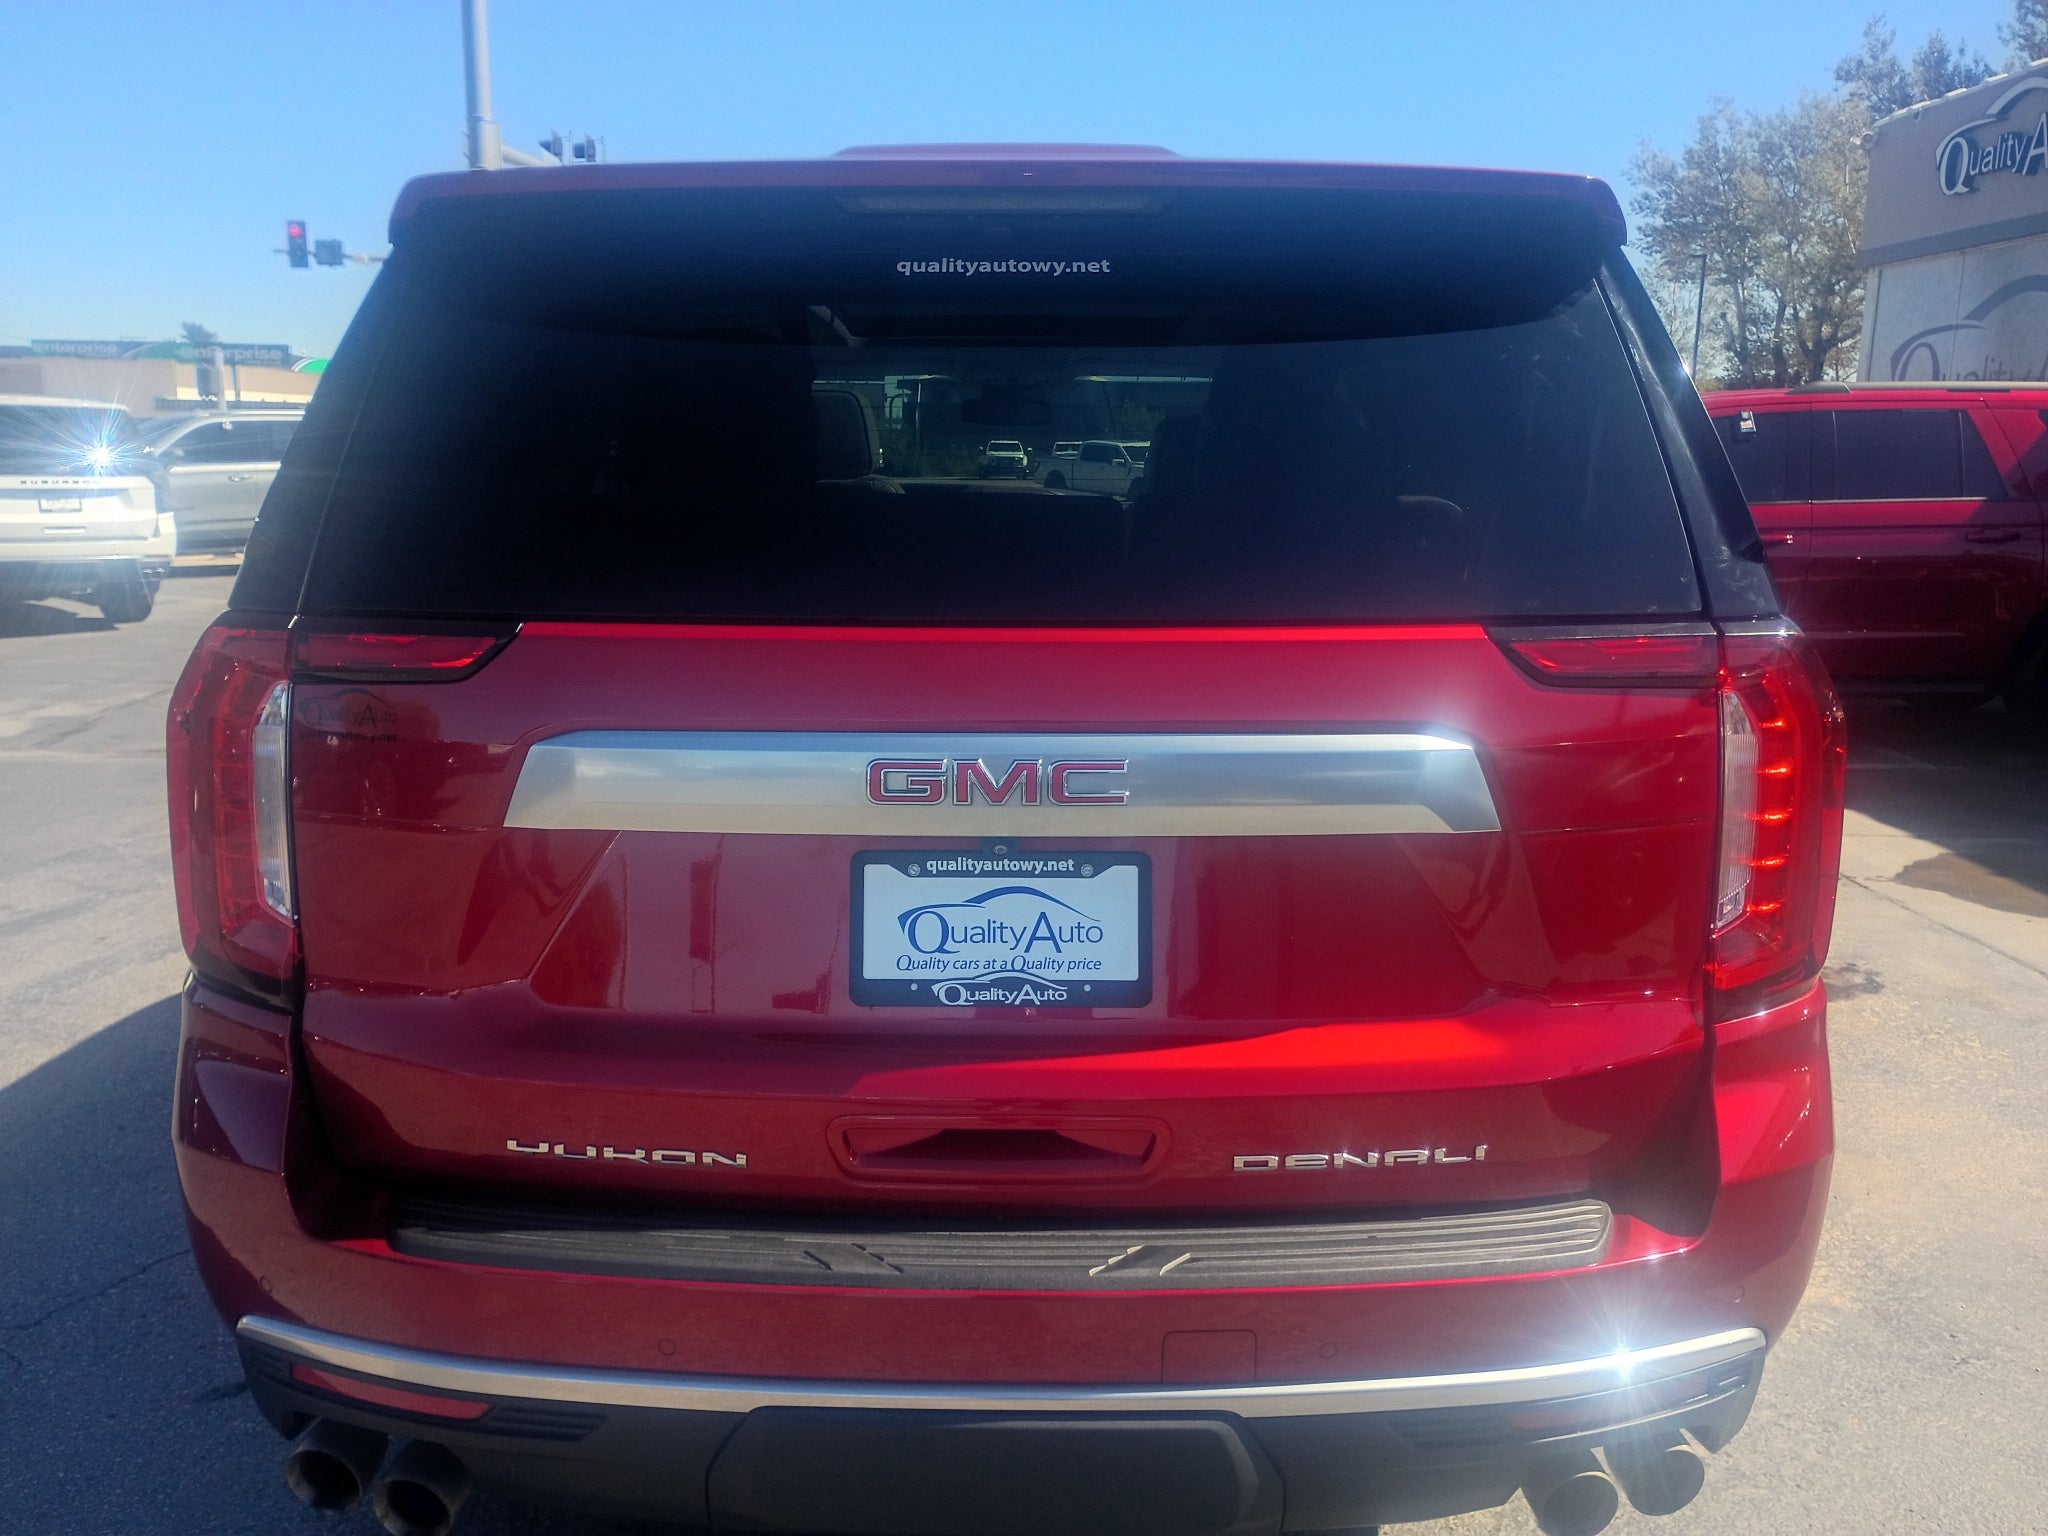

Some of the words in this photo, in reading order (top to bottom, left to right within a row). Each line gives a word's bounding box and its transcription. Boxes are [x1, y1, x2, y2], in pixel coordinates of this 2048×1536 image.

[896, 257, 1110, 277] qualityautowy.net
[177, 345, 283, 362] entrprise
[867, 758, 1130, 806] GMC
[926, 858, 1075, 875] qualityautowy.net
[896, 954, 950, 972] Quality
[952, 959, 980, 970] cars
[983, 957, 998, 970] at
[999, 960, 1008, 970] a
[1010, 955, 1065, 973] Quality
[1067, 957, 1102, 973] price
[506, 1140, 747, 1168] YUKON
[1233, 1144, 1486, 1172] DENALI
